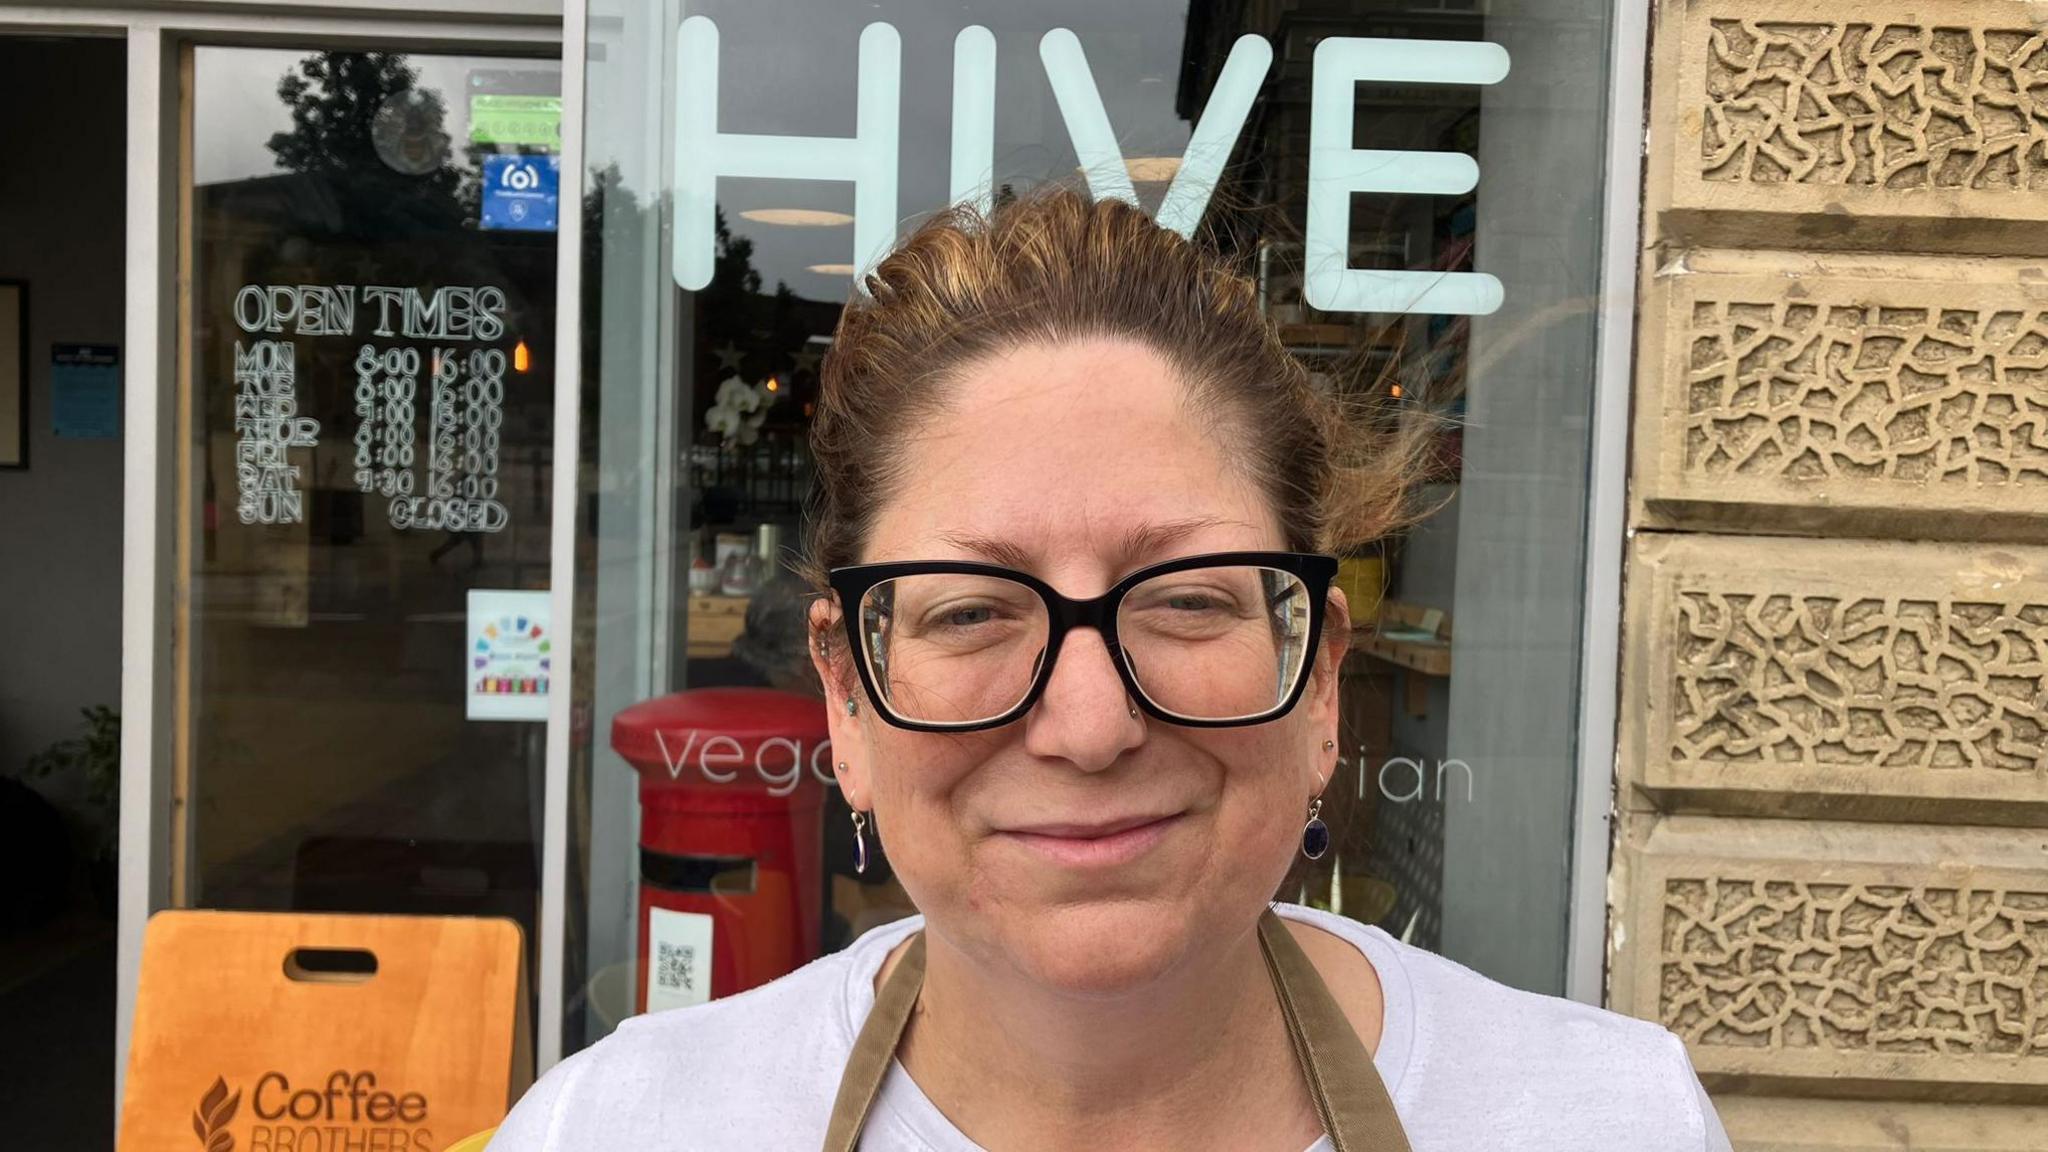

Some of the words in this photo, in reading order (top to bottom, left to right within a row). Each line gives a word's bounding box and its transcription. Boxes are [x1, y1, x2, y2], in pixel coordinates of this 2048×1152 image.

[672, 16, 1511, 315] HIVE
[234, 284, 355, 336] OPEN
[363, 285, 506, 340] TIMES
[234, 340, 294, 373] MON
[355, 344, 419, 376] 8:00
[432, 347, 506, 383] 16:00
[234, 372, 295, 398] TUE
[355, 374, 416, 401] 8:00
[236, 395, 297, 419] WED
[235, 416, 320, 447] THUR
[236, 441, 288, 468] FRI
[238, 464, 300, 492] SAT
[354, 467, 414, 497] 9:30
[237, 491, 302, 524] SUN
[388, 495, 508, 532] CLOSED
[252, 1070, 427, 1122] Coffee
[251, 1125, 434, 1152] BROTHERS
